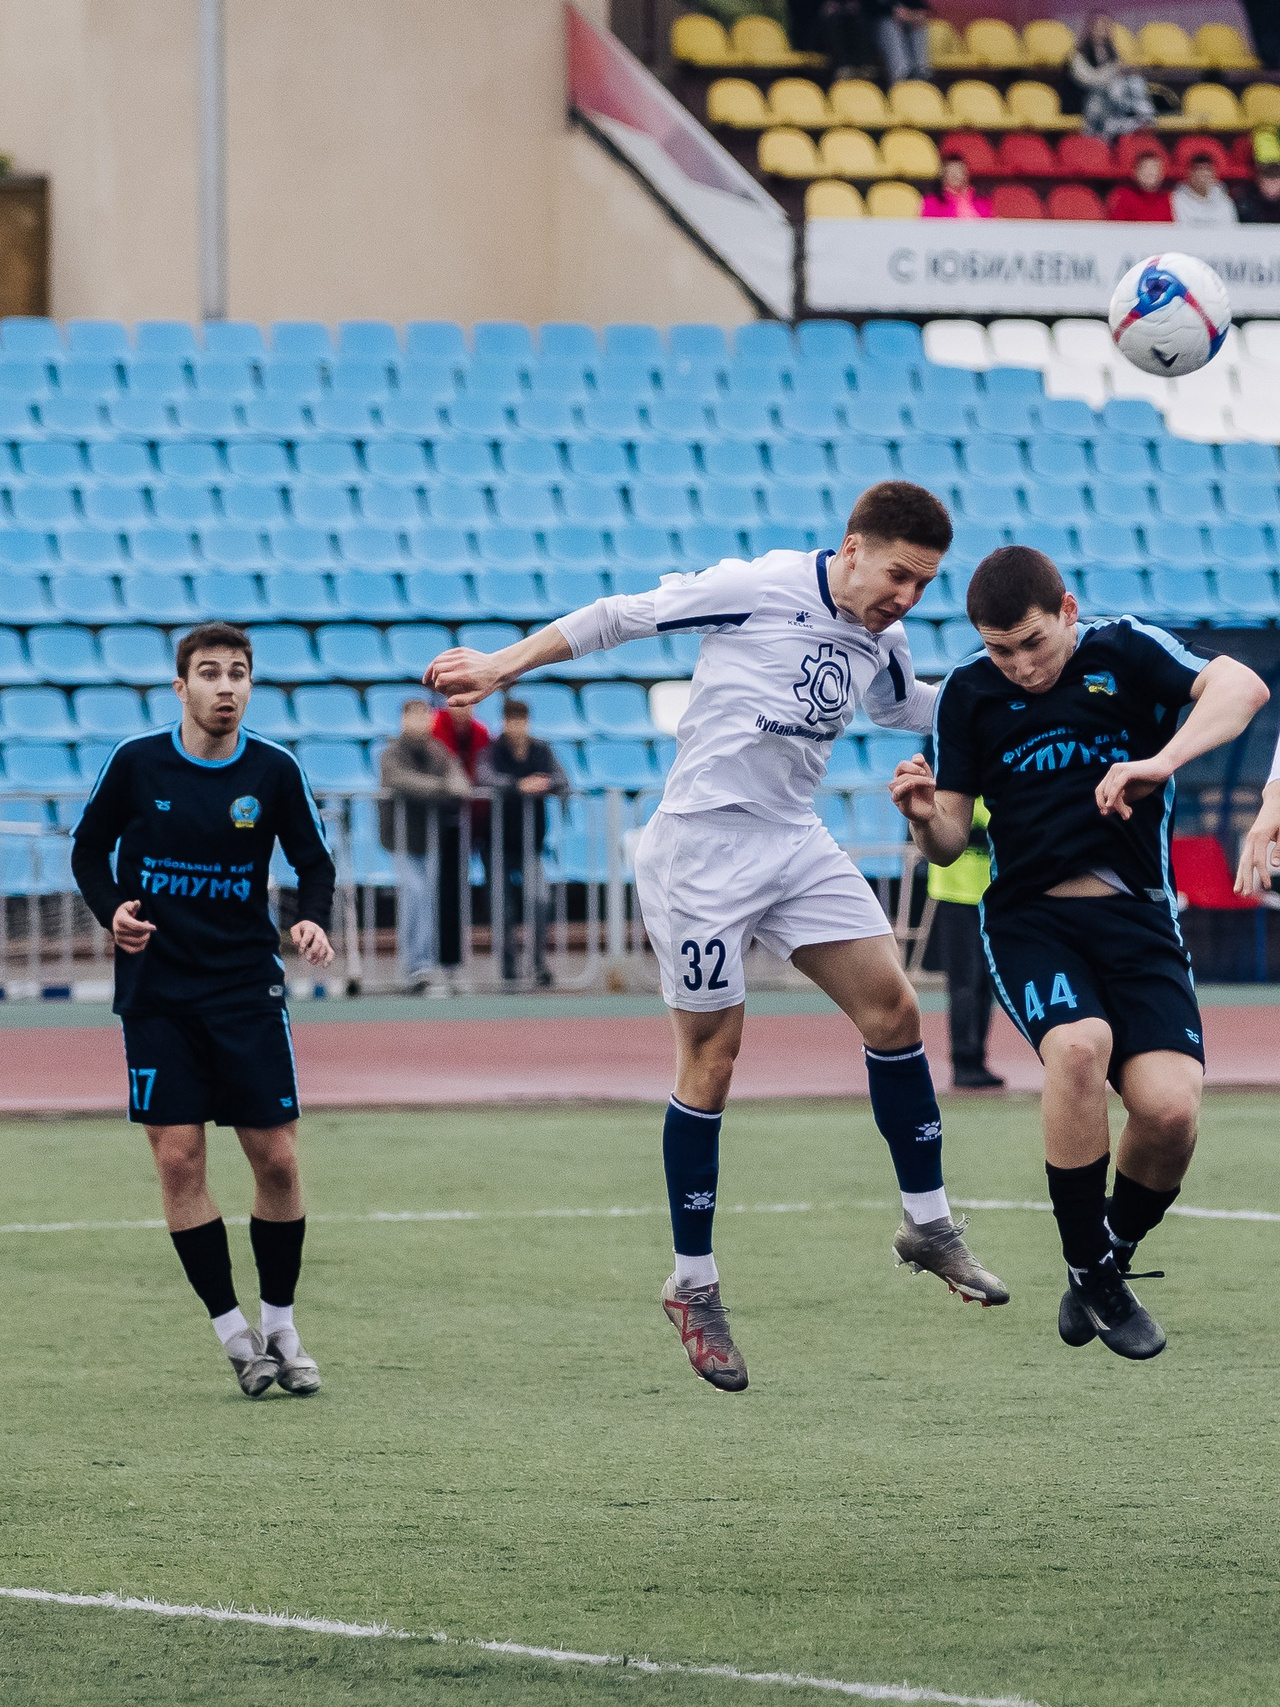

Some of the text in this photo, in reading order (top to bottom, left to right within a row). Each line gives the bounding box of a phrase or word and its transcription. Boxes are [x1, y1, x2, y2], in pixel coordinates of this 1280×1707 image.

[886, 246, 919, 286] С
[140, 869, 252, 902] ТРИУМФ
[680, 937, 729, 992] 32
[1023, 972, 1078, 1023] 44
[129, 1068, 158, 1111] 17
